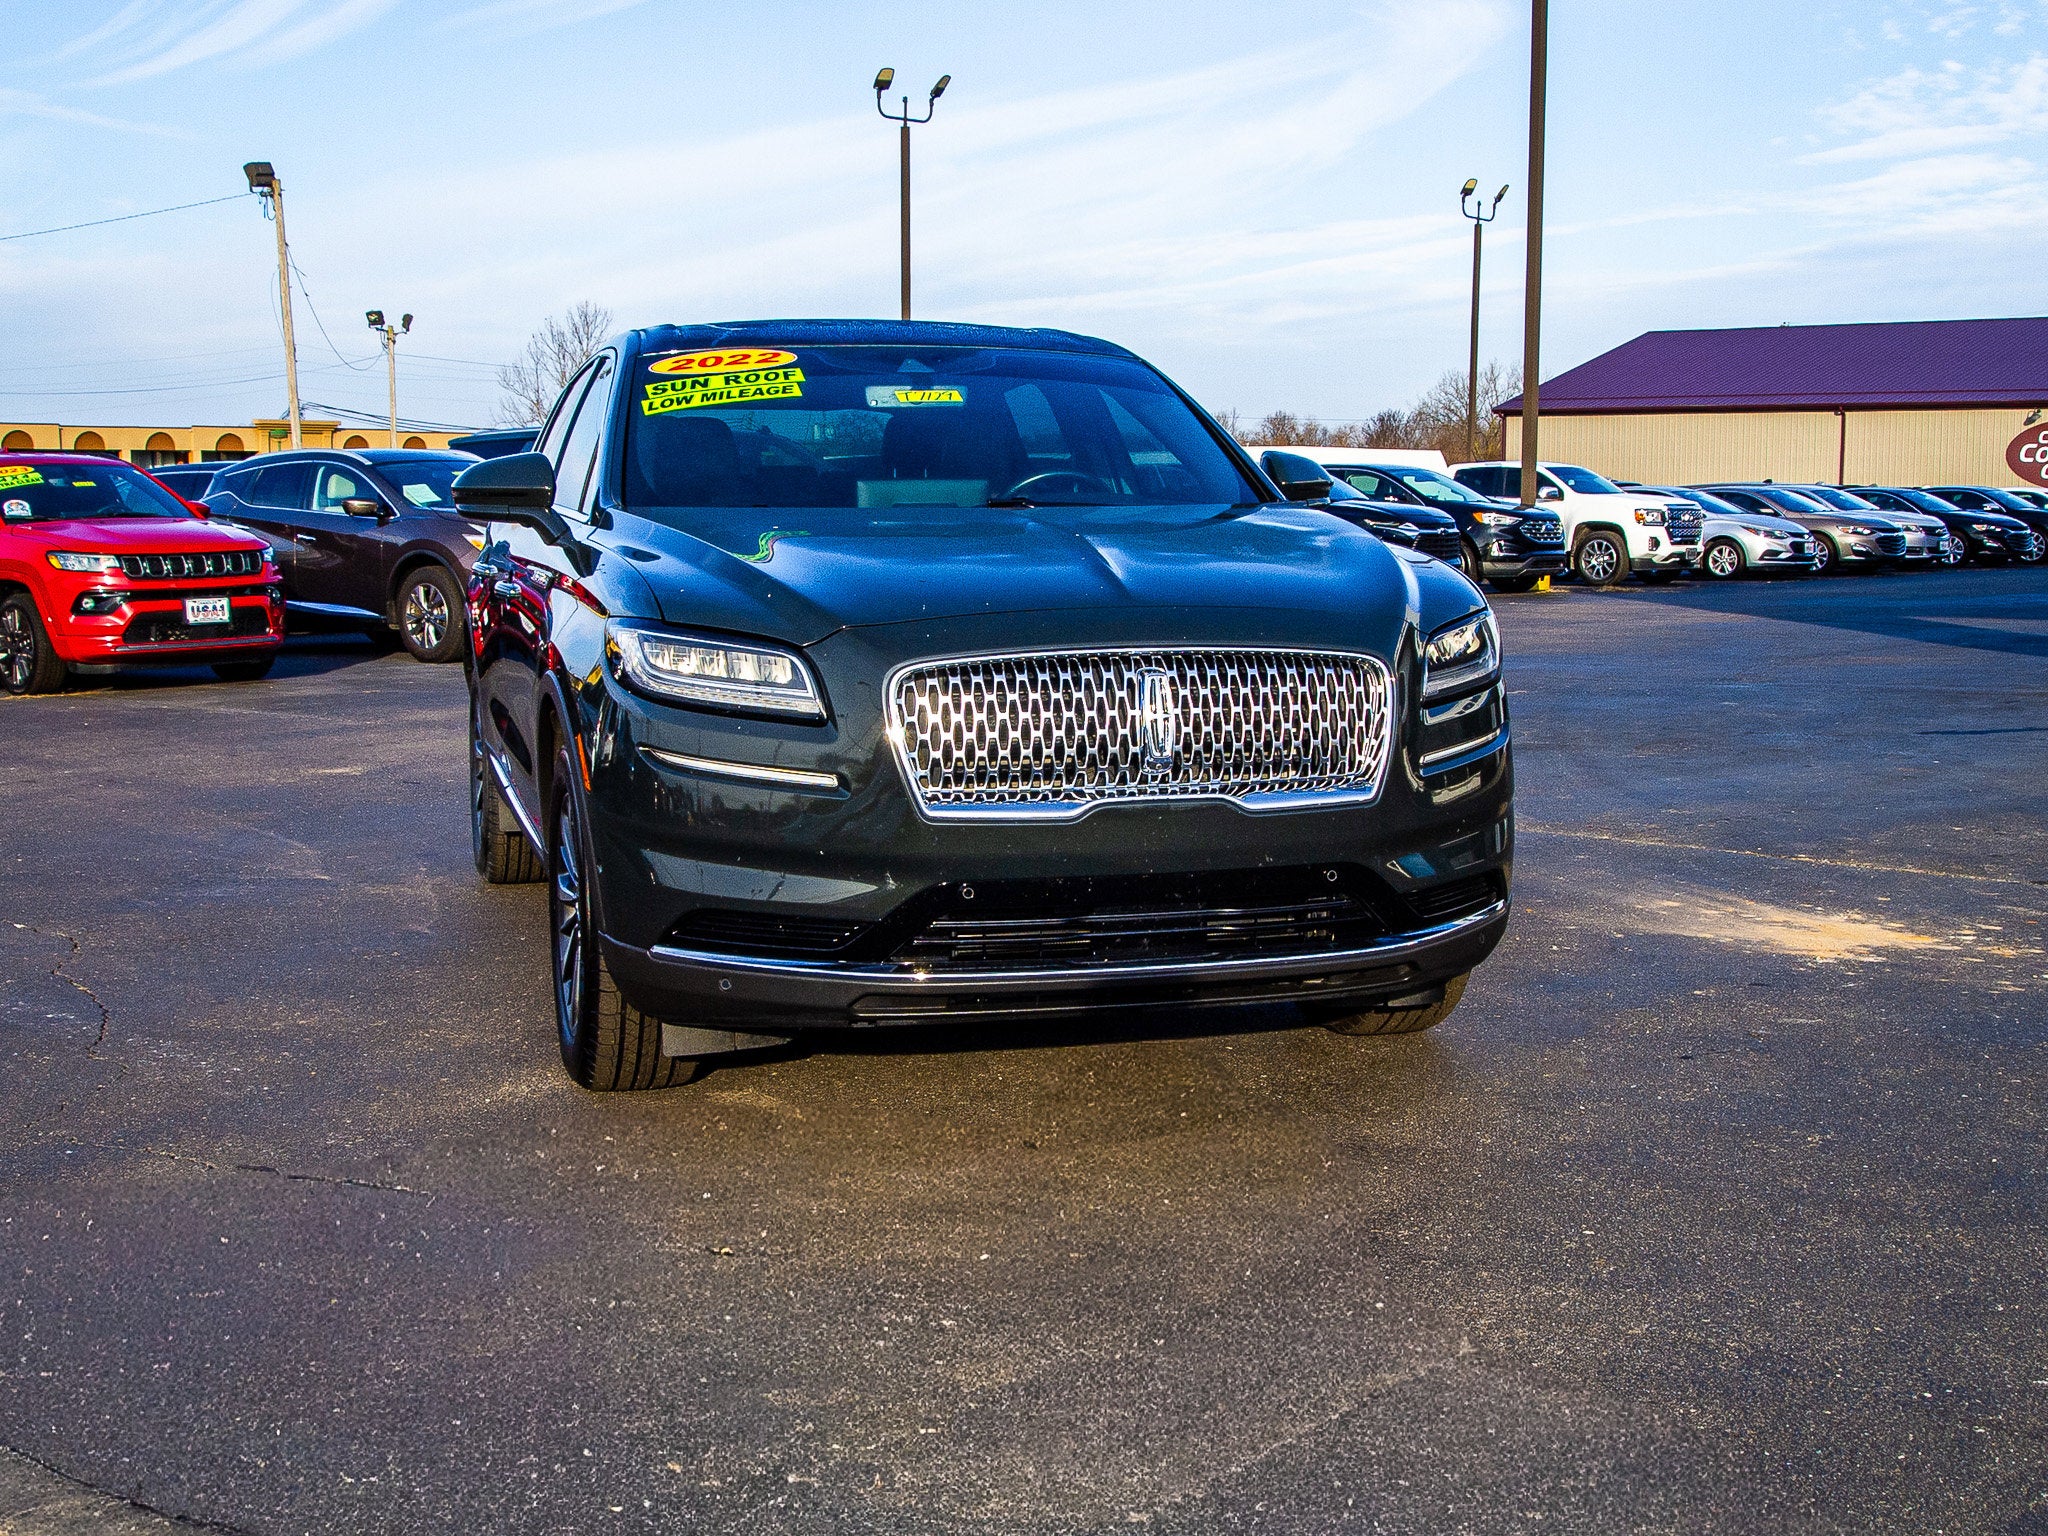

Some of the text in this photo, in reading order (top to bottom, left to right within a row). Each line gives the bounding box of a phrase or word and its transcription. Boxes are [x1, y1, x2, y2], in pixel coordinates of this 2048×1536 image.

[667, 352, 782, 371] 2022
[651, 370, 796, 396] SUN ROOF
[647, 385, 795, 411] LOW MILEAGE
